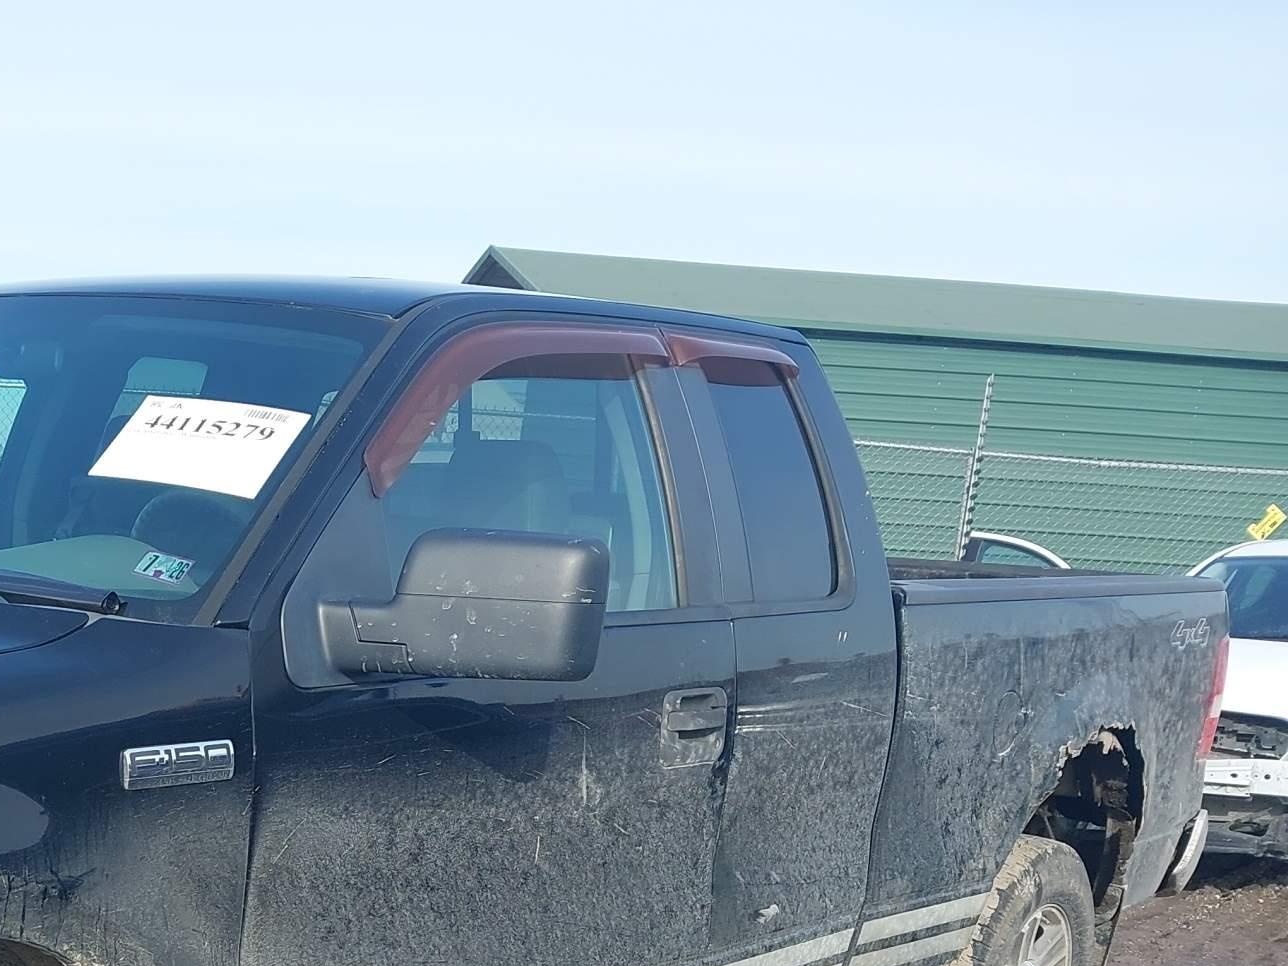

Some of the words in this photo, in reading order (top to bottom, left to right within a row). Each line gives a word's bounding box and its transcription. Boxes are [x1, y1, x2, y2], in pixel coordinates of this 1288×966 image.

[145, 414, 275, 442] 44115279
[142, 554, 160, 573] 7
[168, 560, 190, 580] 26
[1170, 617, 1211, 650] 4x4
[129, 742, 232, 777] F-150
